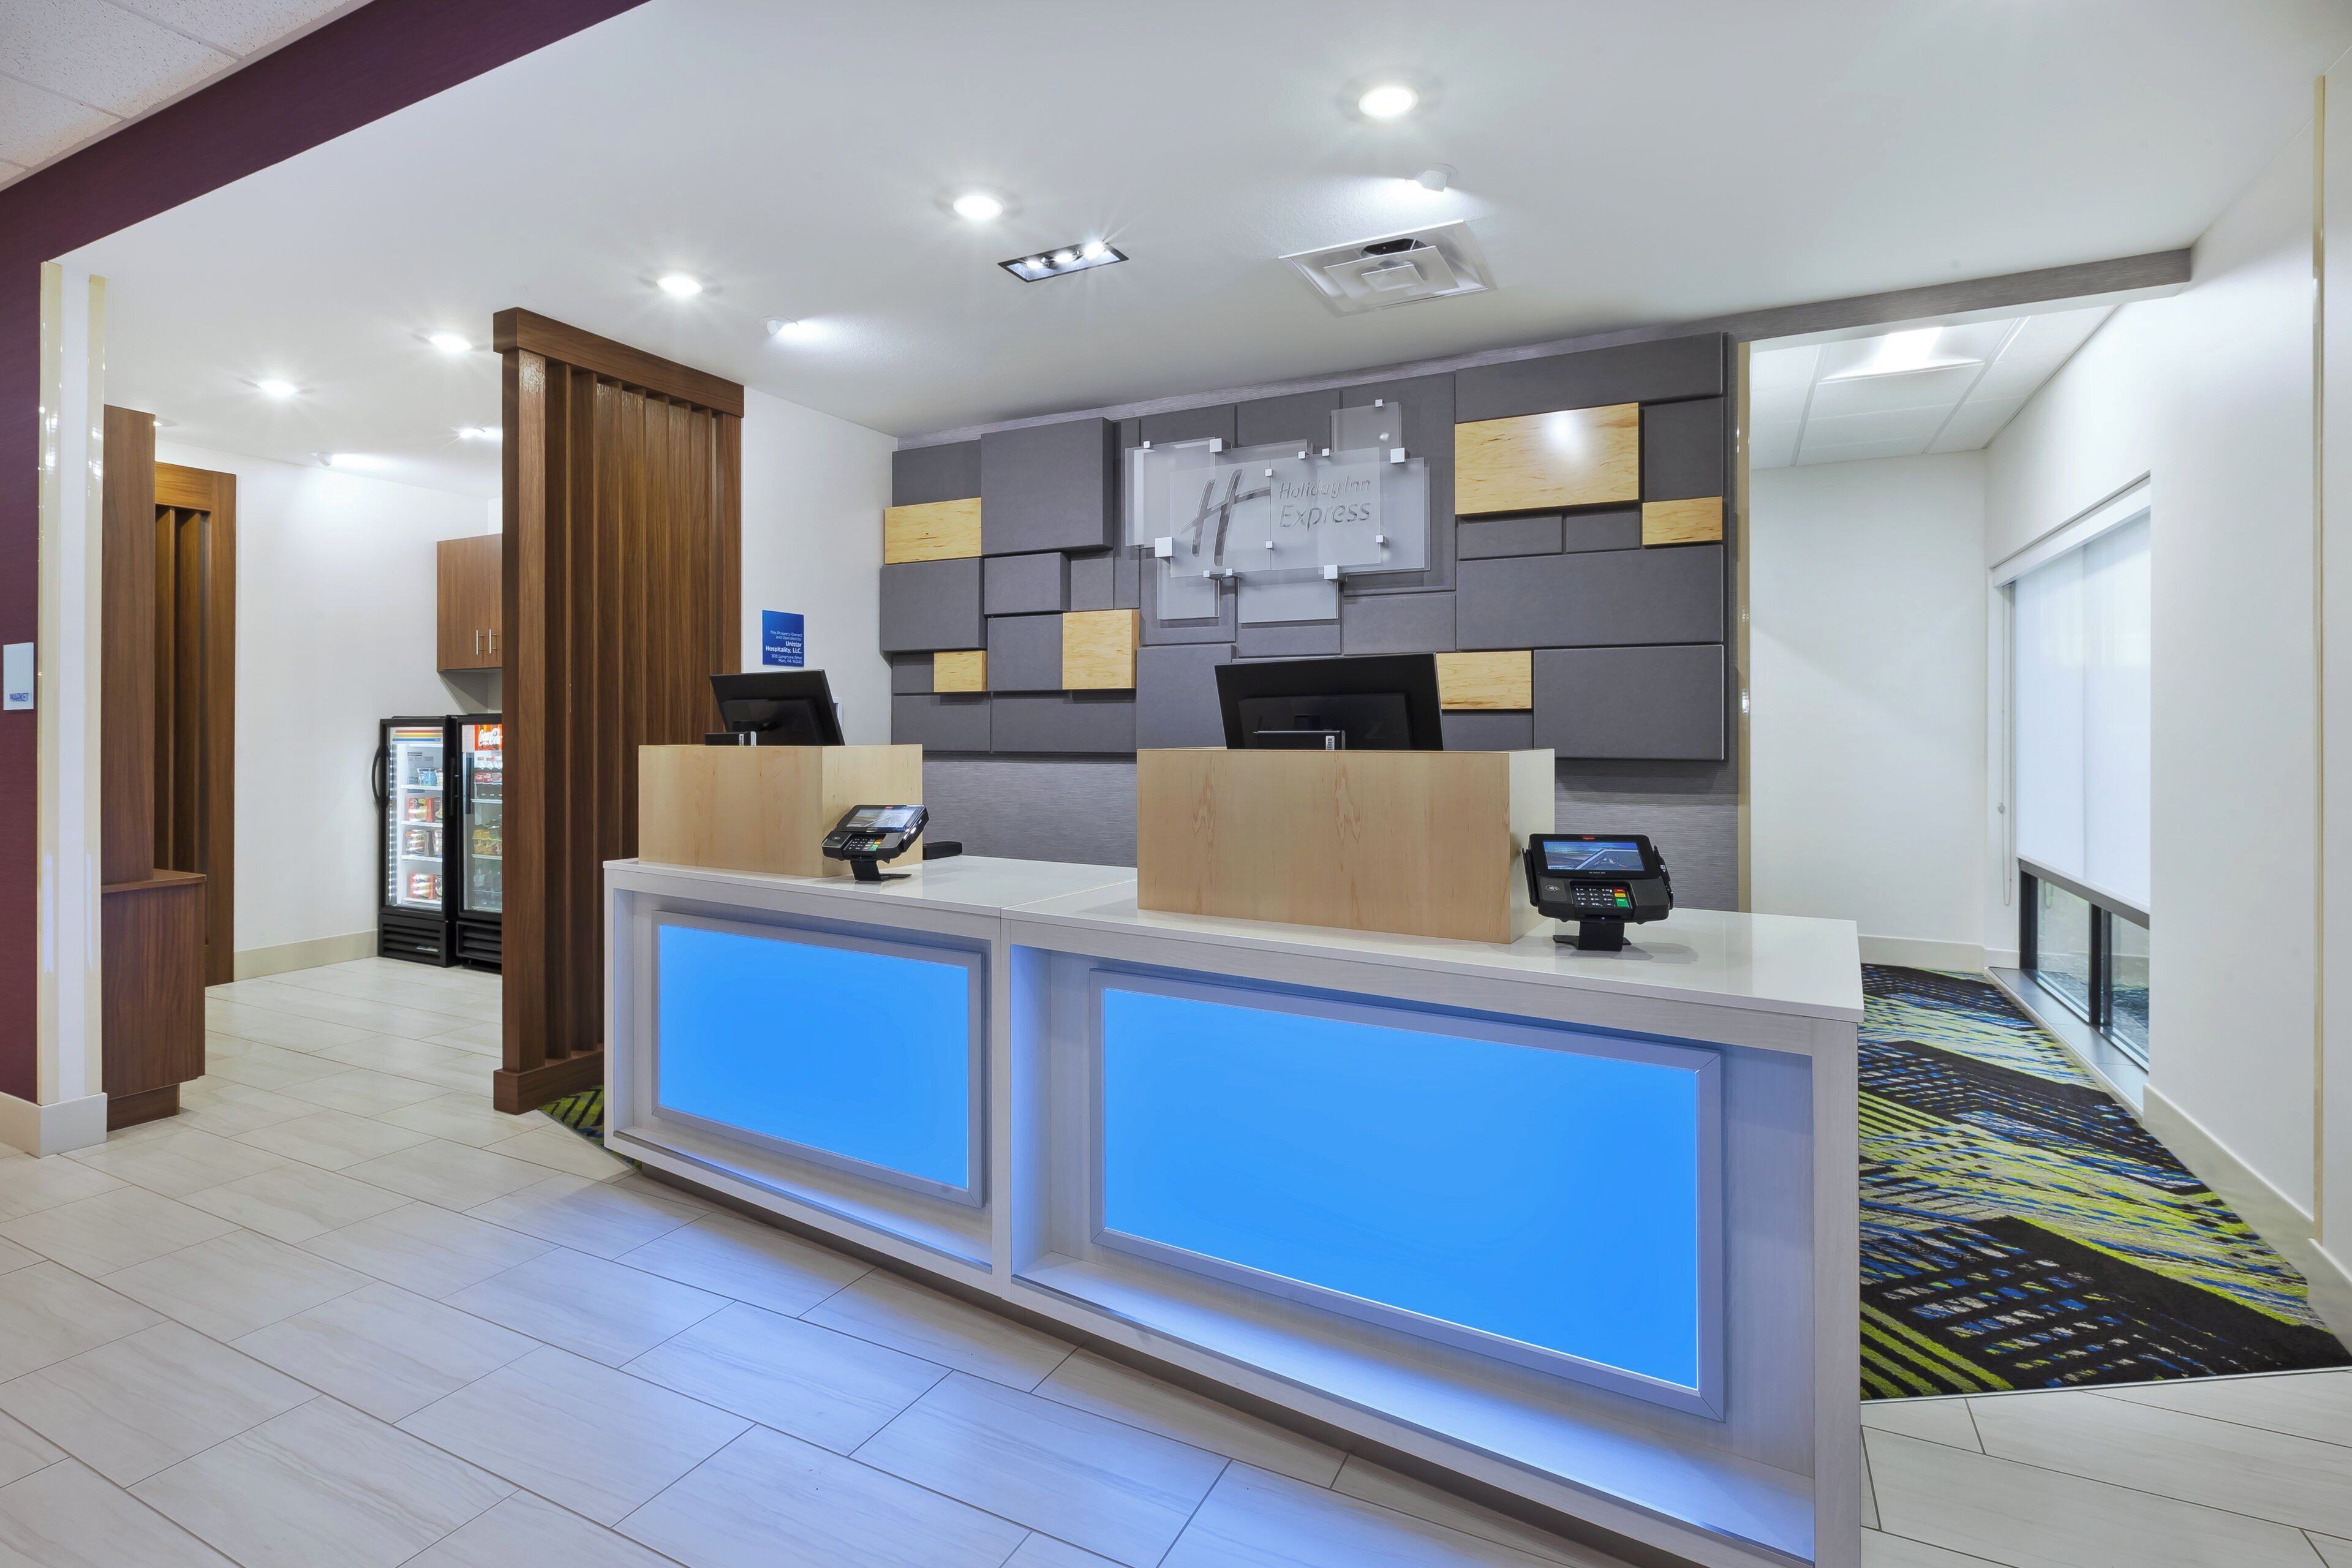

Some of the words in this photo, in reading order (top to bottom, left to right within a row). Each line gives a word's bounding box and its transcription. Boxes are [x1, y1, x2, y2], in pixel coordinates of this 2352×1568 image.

[1279, 479, 1341, 499] Holiday
[1344, 476, 1371, 493] Inn
[1279, 503, 1371, 532] Express
